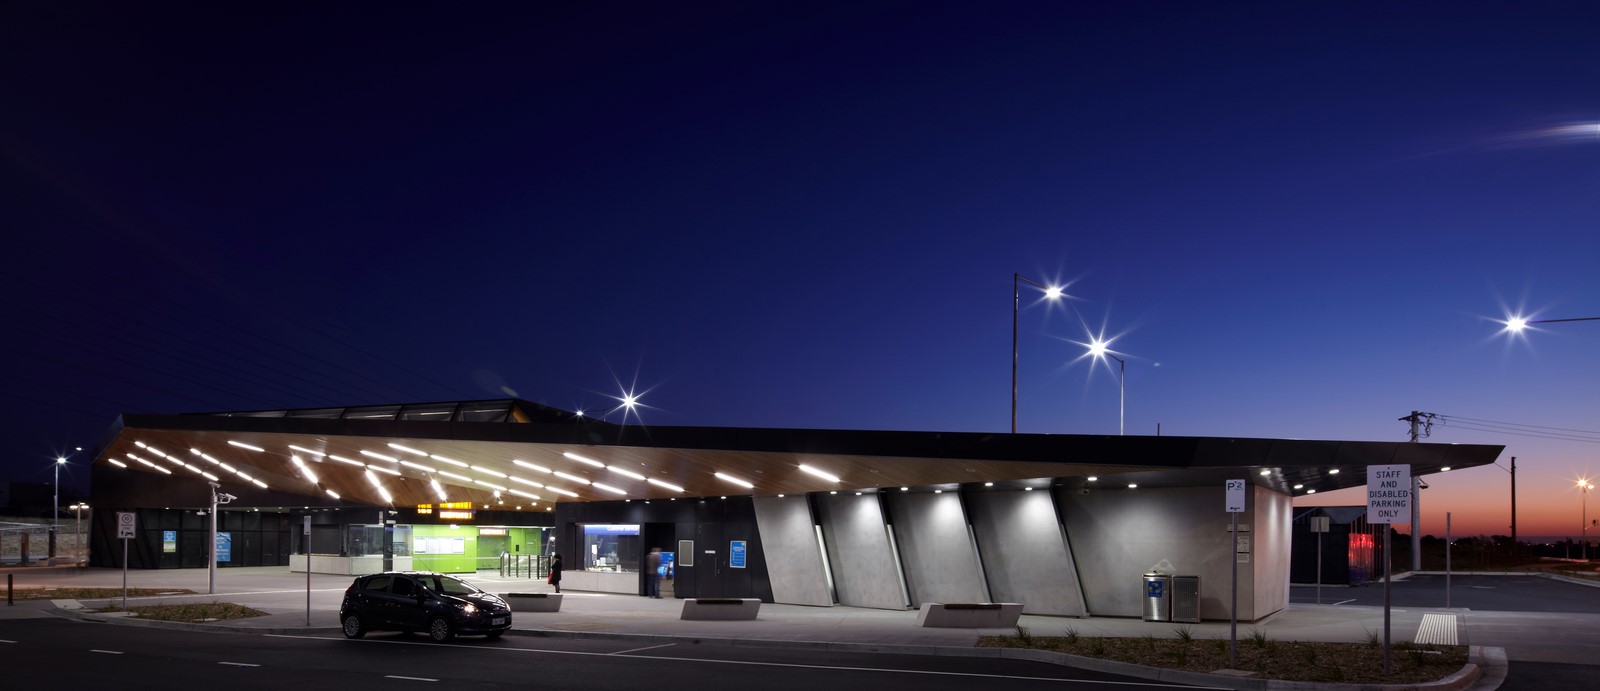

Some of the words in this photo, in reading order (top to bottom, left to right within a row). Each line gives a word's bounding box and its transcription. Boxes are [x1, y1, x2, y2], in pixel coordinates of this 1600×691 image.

[1227, 482, 1235, 491] P
[1371, 500, 1406, 508] PARKING
[1378, 510, 1399, 518] ONLY
